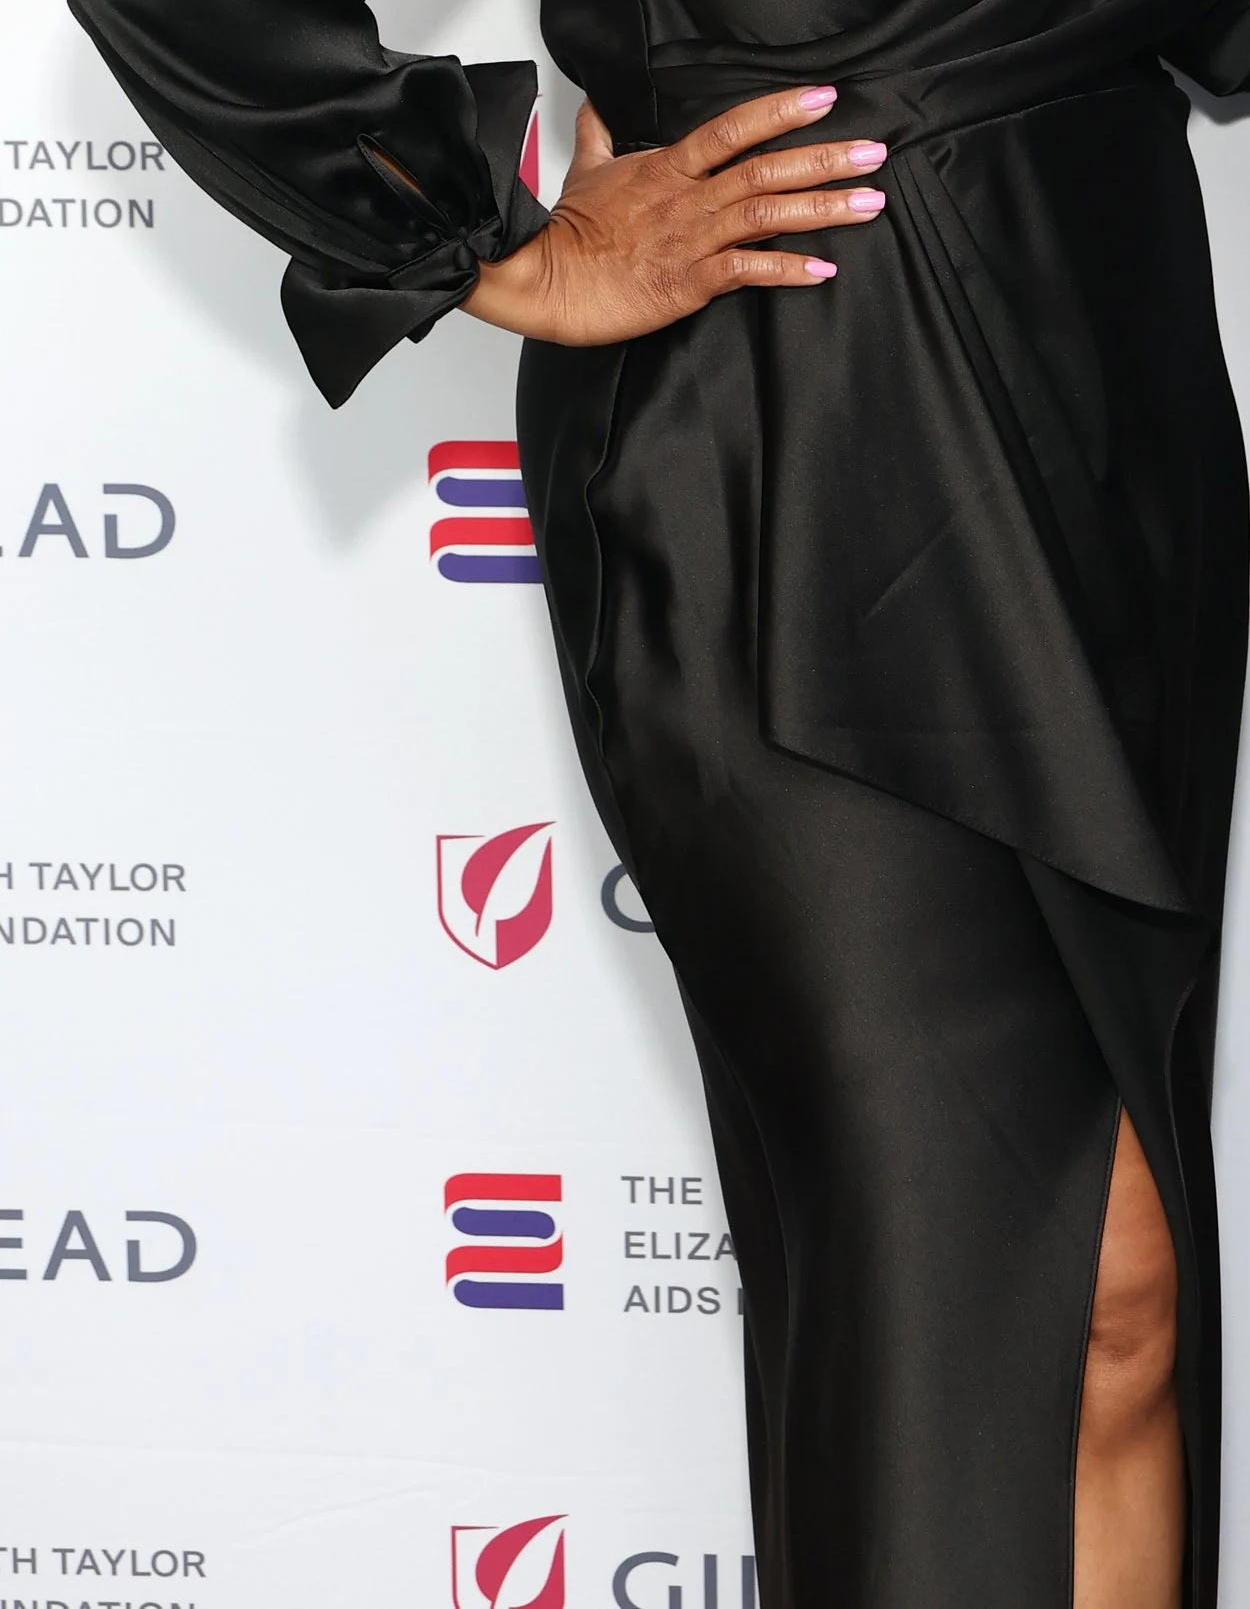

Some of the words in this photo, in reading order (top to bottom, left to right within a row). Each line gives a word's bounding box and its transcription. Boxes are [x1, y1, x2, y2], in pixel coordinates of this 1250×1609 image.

[4, 141, 166, 172] TAYLOR
[0, 482, 177, 560] AD
[28, 862, 187, 892] TAYLOR
[621, 1175, 703, 1206] THE
[623, 1284, 721, 1316] AIDS
[51, 1547, 206, 1578] TAYLOR
